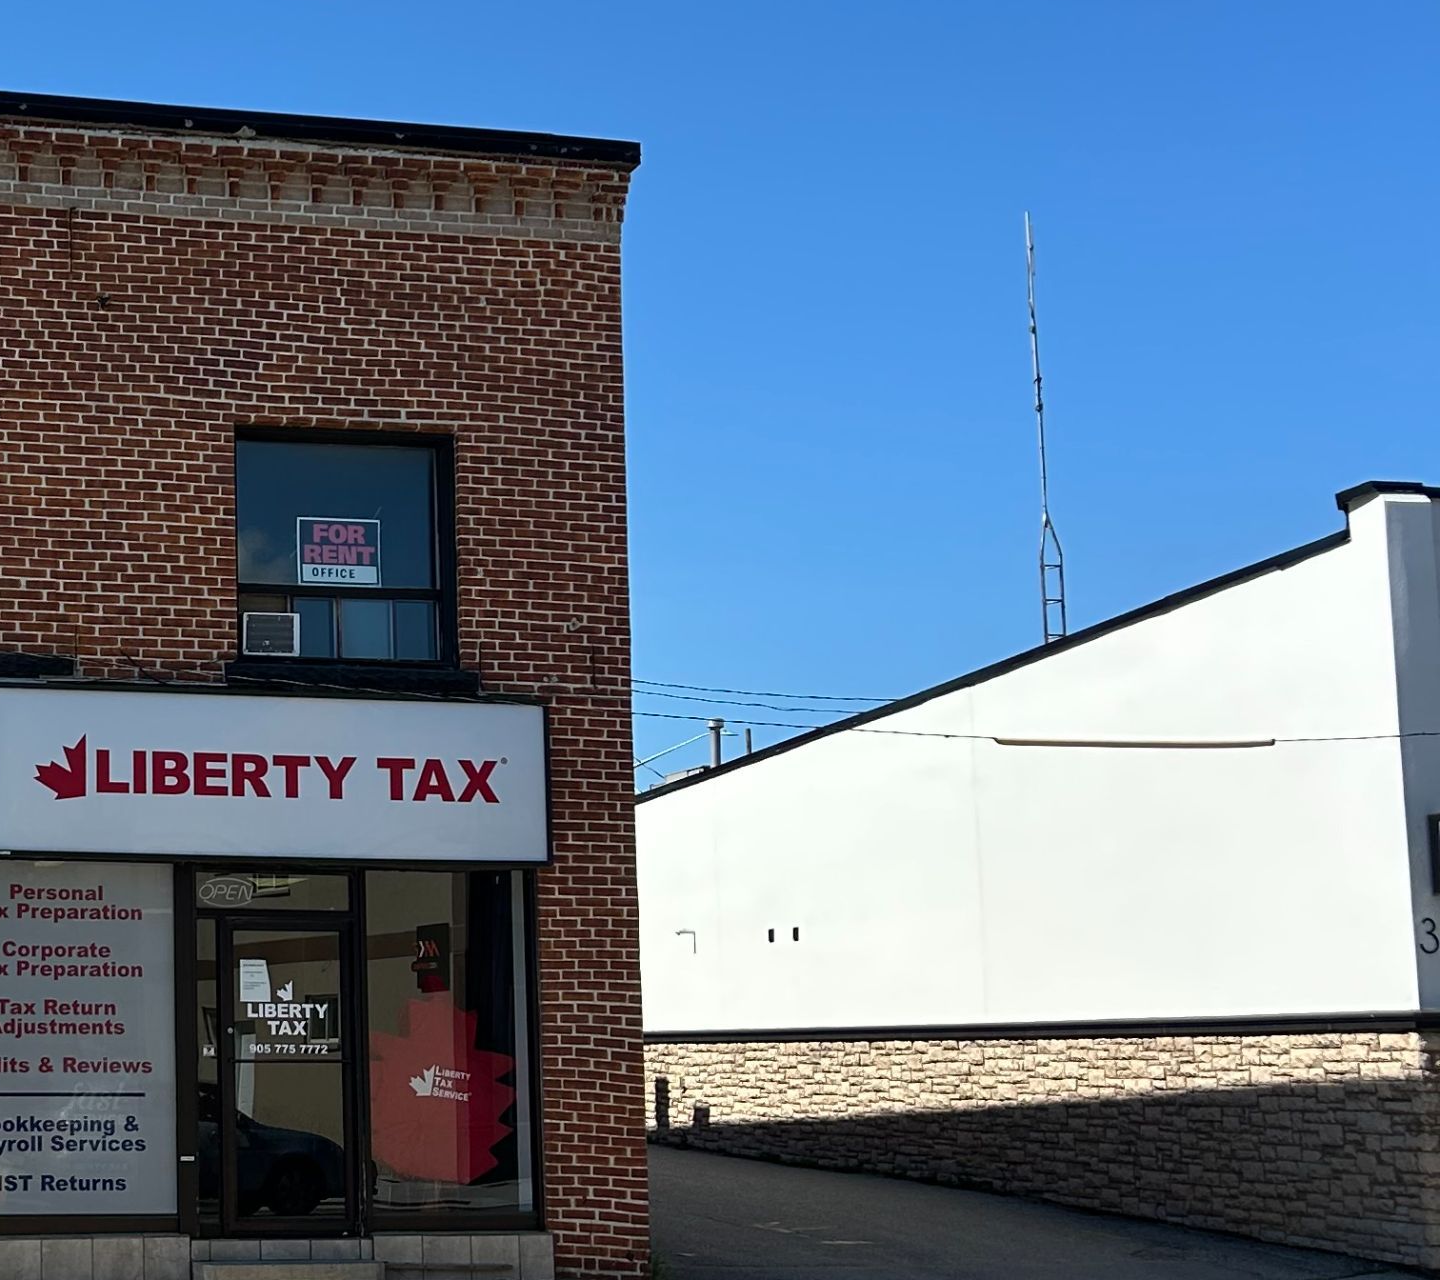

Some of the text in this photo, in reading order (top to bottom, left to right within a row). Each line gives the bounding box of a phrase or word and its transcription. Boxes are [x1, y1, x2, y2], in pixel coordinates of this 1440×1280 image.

[312, 523, 365, 544] FOR
[303, 544, 375, 565] RENT
[312, 567, 356, 579] OFFICE
[95, 748, 500, 803] LIBERTY TAX
[9, 884, 104, 901] Personal
[199, 883, 254, 900] OPEN
[16, 903, 143, 923] Preparation
[1420, 917, 1439, 955] 3
[2, 941, 111, 962] Corporate
[16, 960, 143, 980] Preparation
[44, 999, 117, 1016] Return
[247, 1003, 328, 1019] LIBERTY
[267, 1020, 307, 1036] TAX
[249, 1043, 328, 1055] 905 775 7772
[38, 1056, 54, 1073] &
[62, 1057, 153, 1074] Reviews
[123, 1115, 140, 1133] &
[50, 1135, 147, 1152] Services
[40, 1175, 127, 1193] Returns
